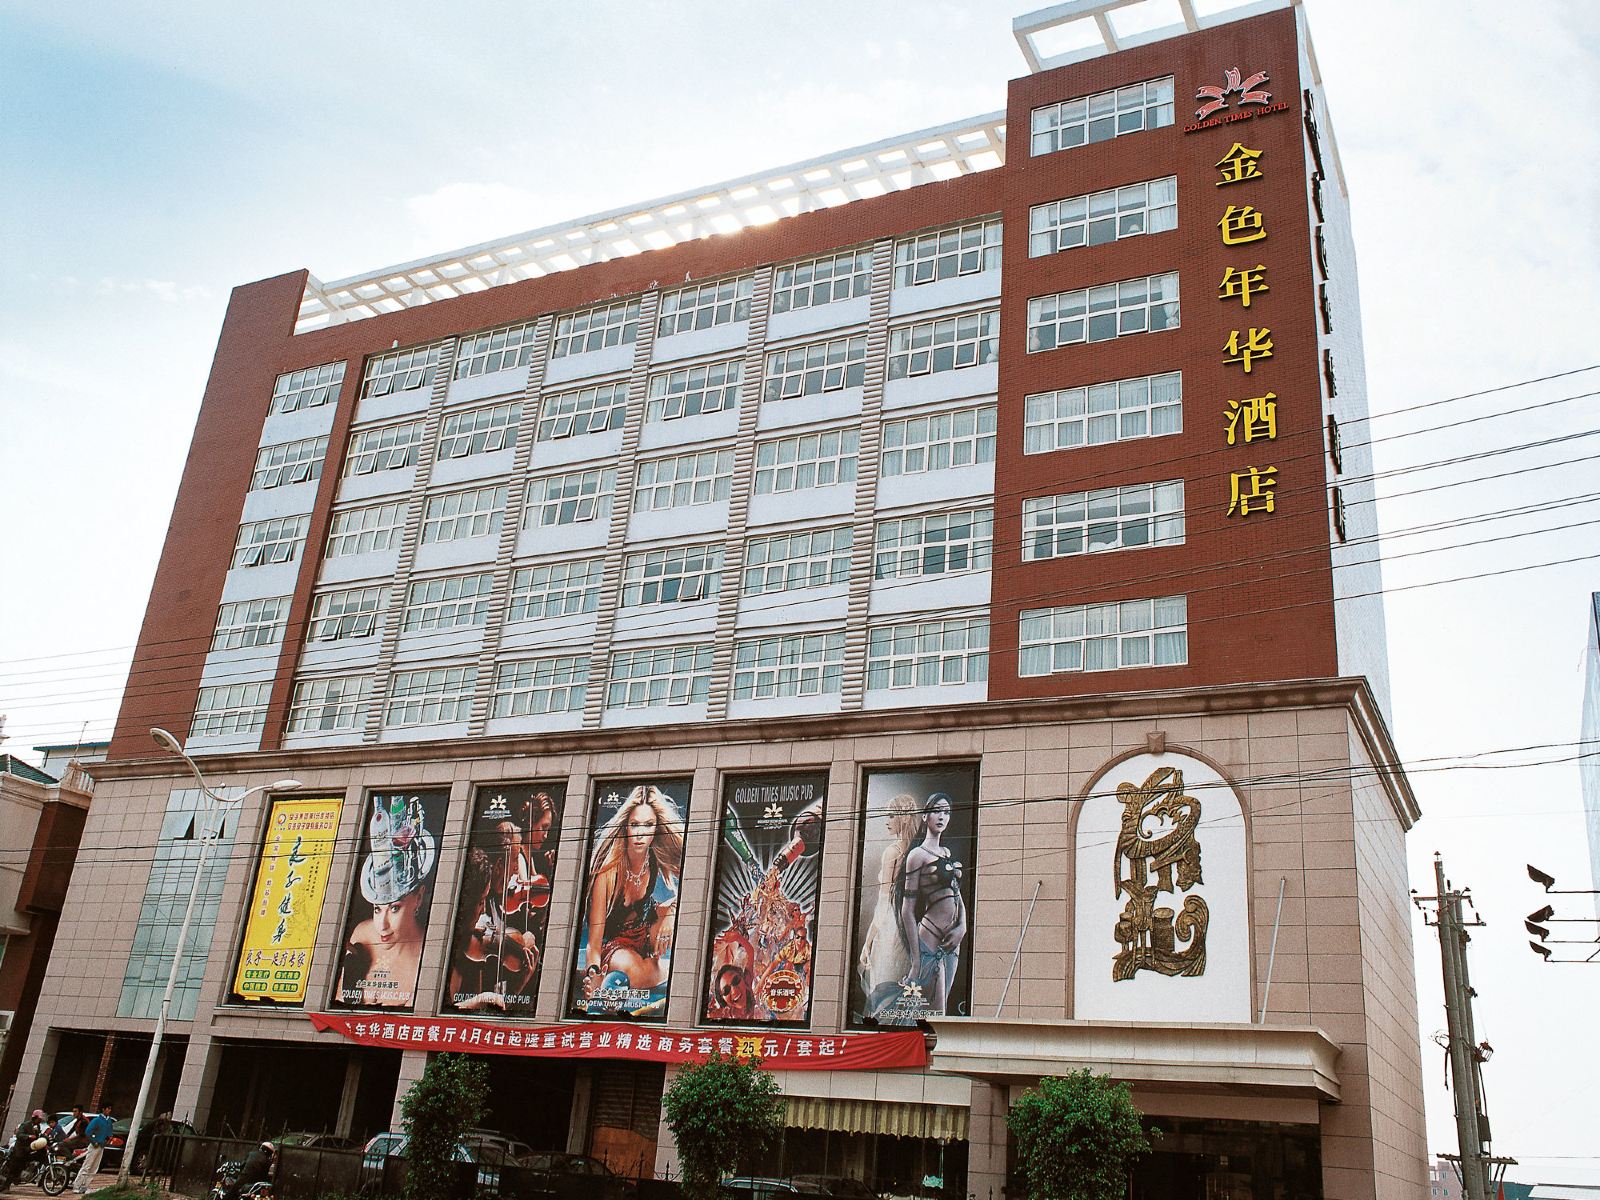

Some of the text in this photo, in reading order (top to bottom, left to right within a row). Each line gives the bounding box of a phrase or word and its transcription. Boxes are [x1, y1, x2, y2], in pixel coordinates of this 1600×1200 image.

[1183, 102, 1290, 133] GOLDEN TIMES HOTEL
[1215, 142, 1278, 517] 金色年华酒店
[735, 784, 814, 803] GOLDEN TIMES MUSIC PUB
[518, 995, 531, 1005] PUB
